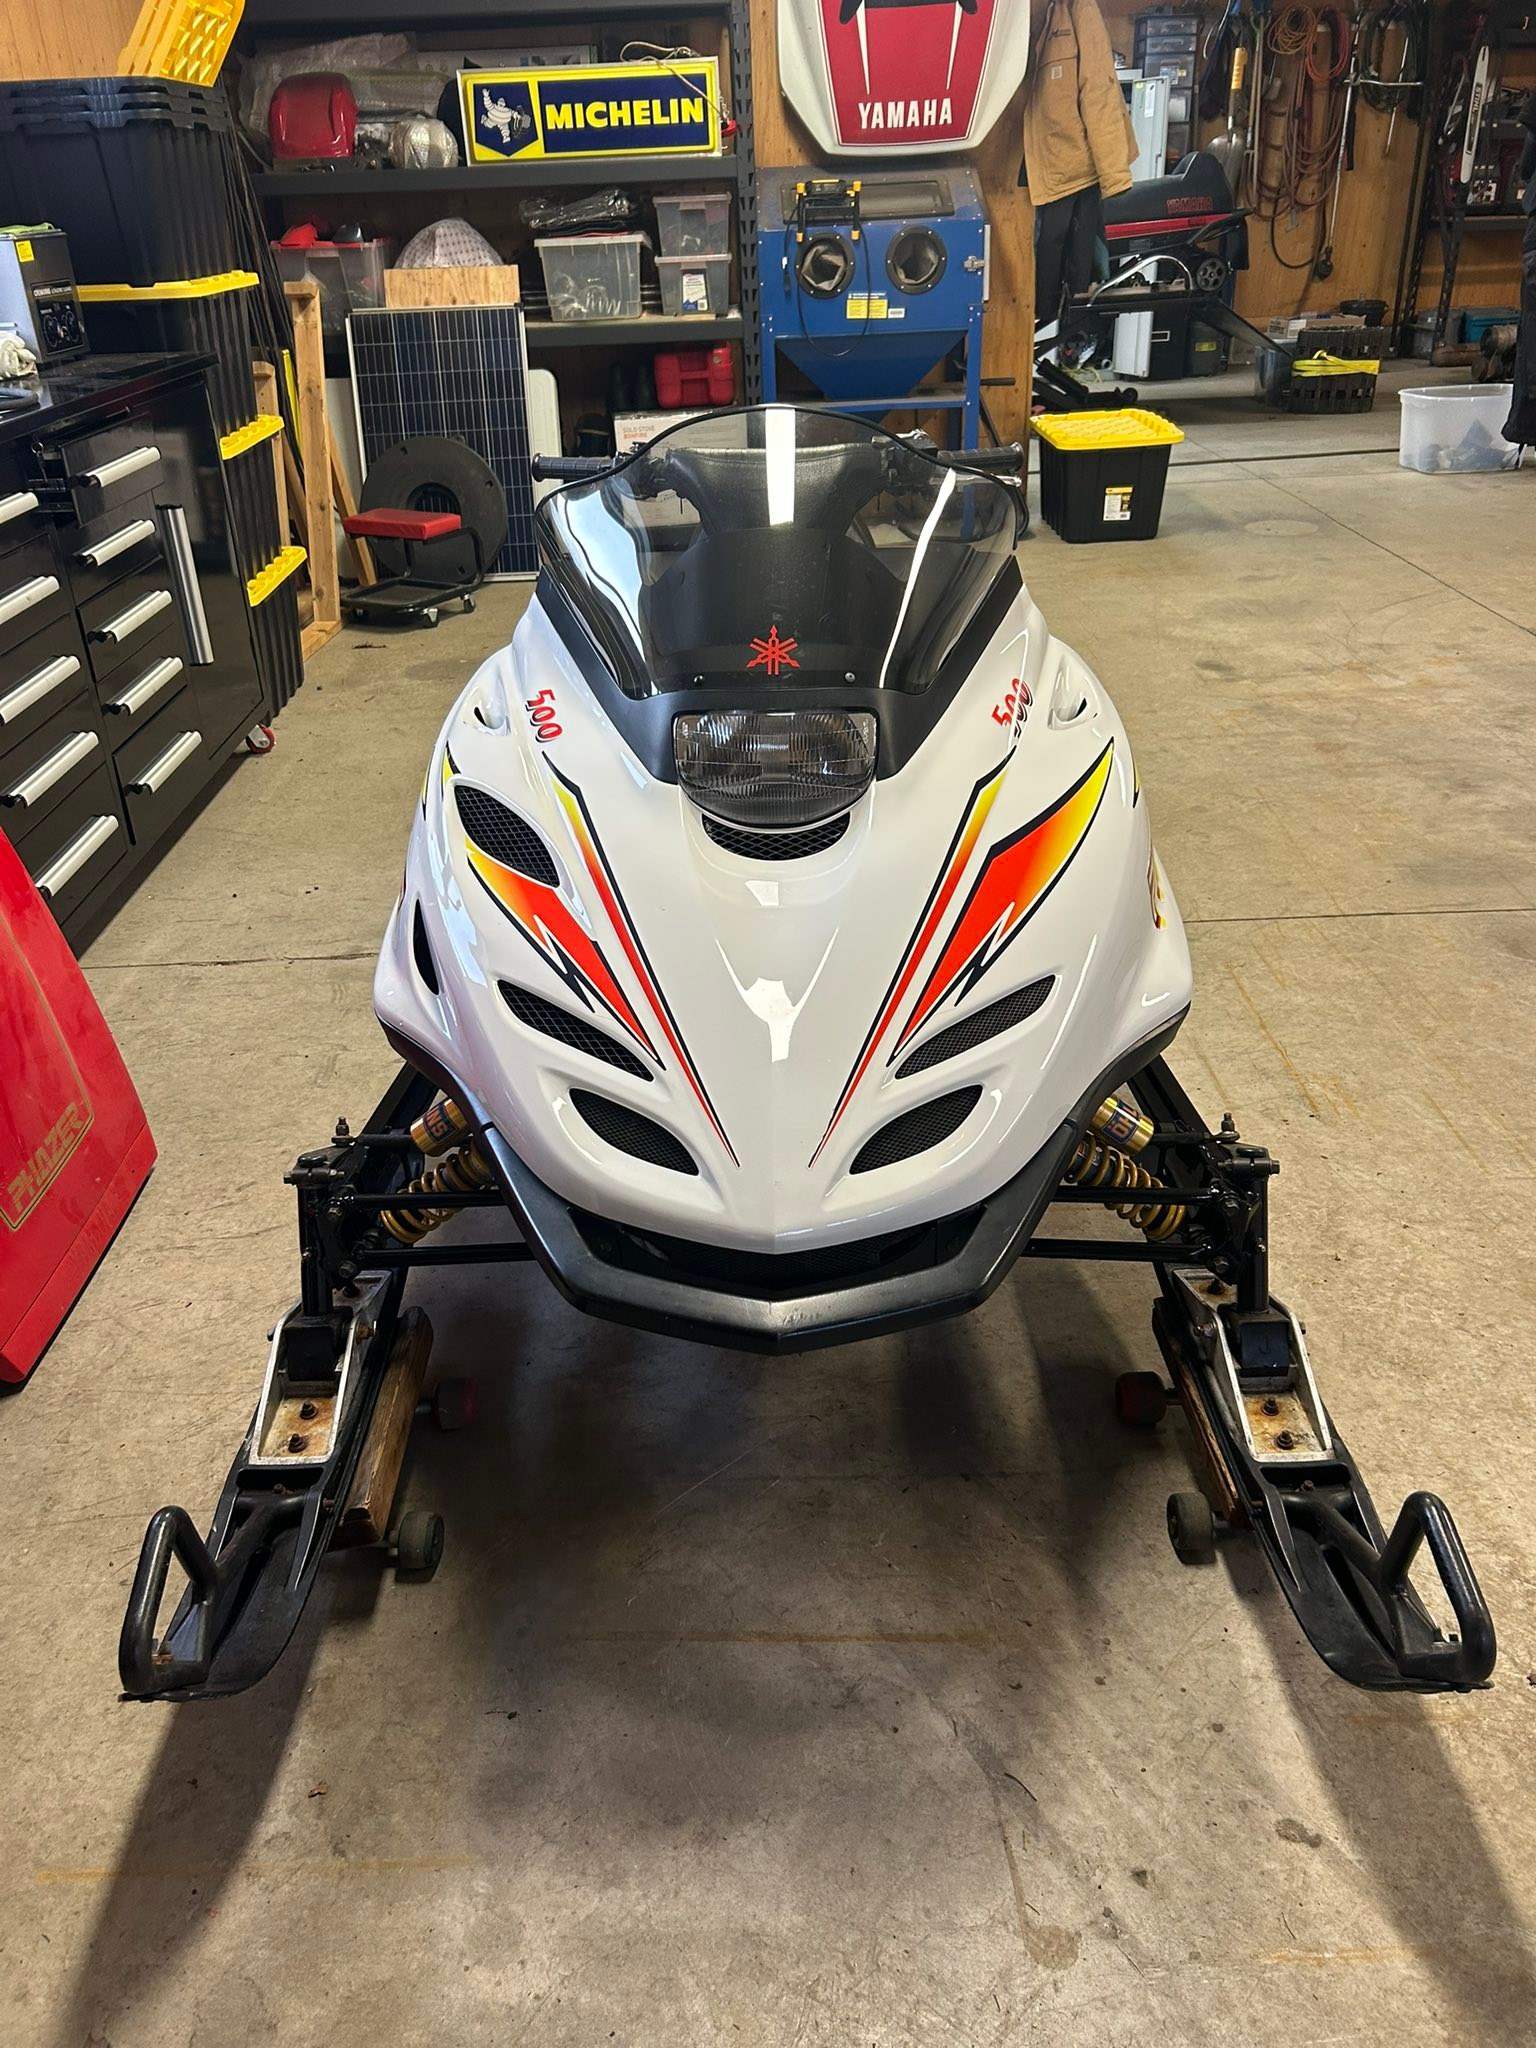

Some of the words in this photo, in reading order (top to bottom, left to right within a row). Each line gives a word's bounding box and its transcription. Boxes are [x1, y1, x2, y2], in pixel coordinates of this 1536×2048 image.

[545, 97, 704, 130] MICHELIN
[858, 98, 952, 129] YAMAHA
[1166, 197, 1212, 214] YAMAHA
[525, 689, 563, 743] 500
[991, 678, 1033, 738] 500
[8, 1101, 84, 1212] PHAZER
